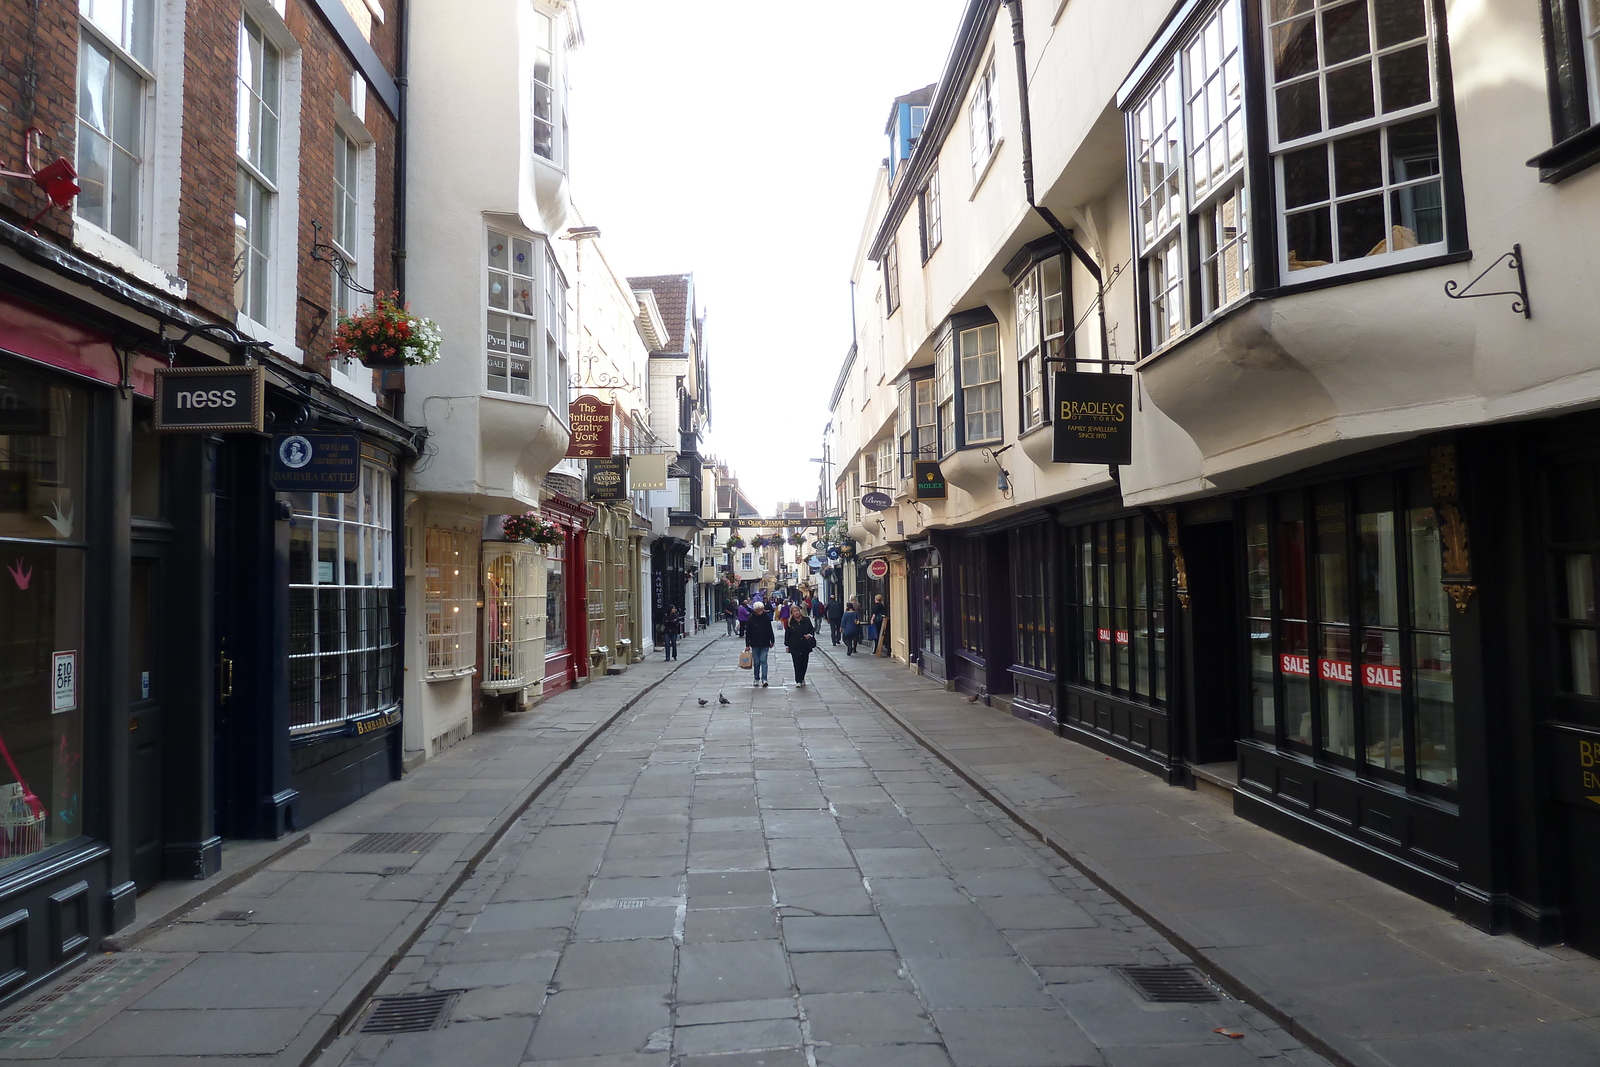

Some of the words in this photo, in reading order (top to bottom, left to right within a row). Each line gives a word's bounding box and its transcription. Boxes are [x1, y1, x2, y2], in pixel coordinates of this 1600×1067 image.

[487, 334, 525, 349] Pyramid
[487, 359, 524, 371] GALLERY
[177, 389, 237, 409] ness
[579, 403, 597, 412] The
[1060, 400, 1125, 422] BRADLEYS
[569, 413, 609, 424] Antiques
[571, 422, 603, 432] Centre
[575, 432, 598, 442] York
[313, 457, 353, 465] SILVERSMITH
[274, 471, 318, 481] BARBARA
[321, 472, 355, 482] CATTLE
[57, 662, 72, 677] £10
[1283, 656, 1310, 674] SALE
[1322, 661, 1352, 681] SALE
[56, 675, 72, 689] OFF
[1366, 666, 1401, 687] SALE
[356, 717, 387, 735] BARBARA
